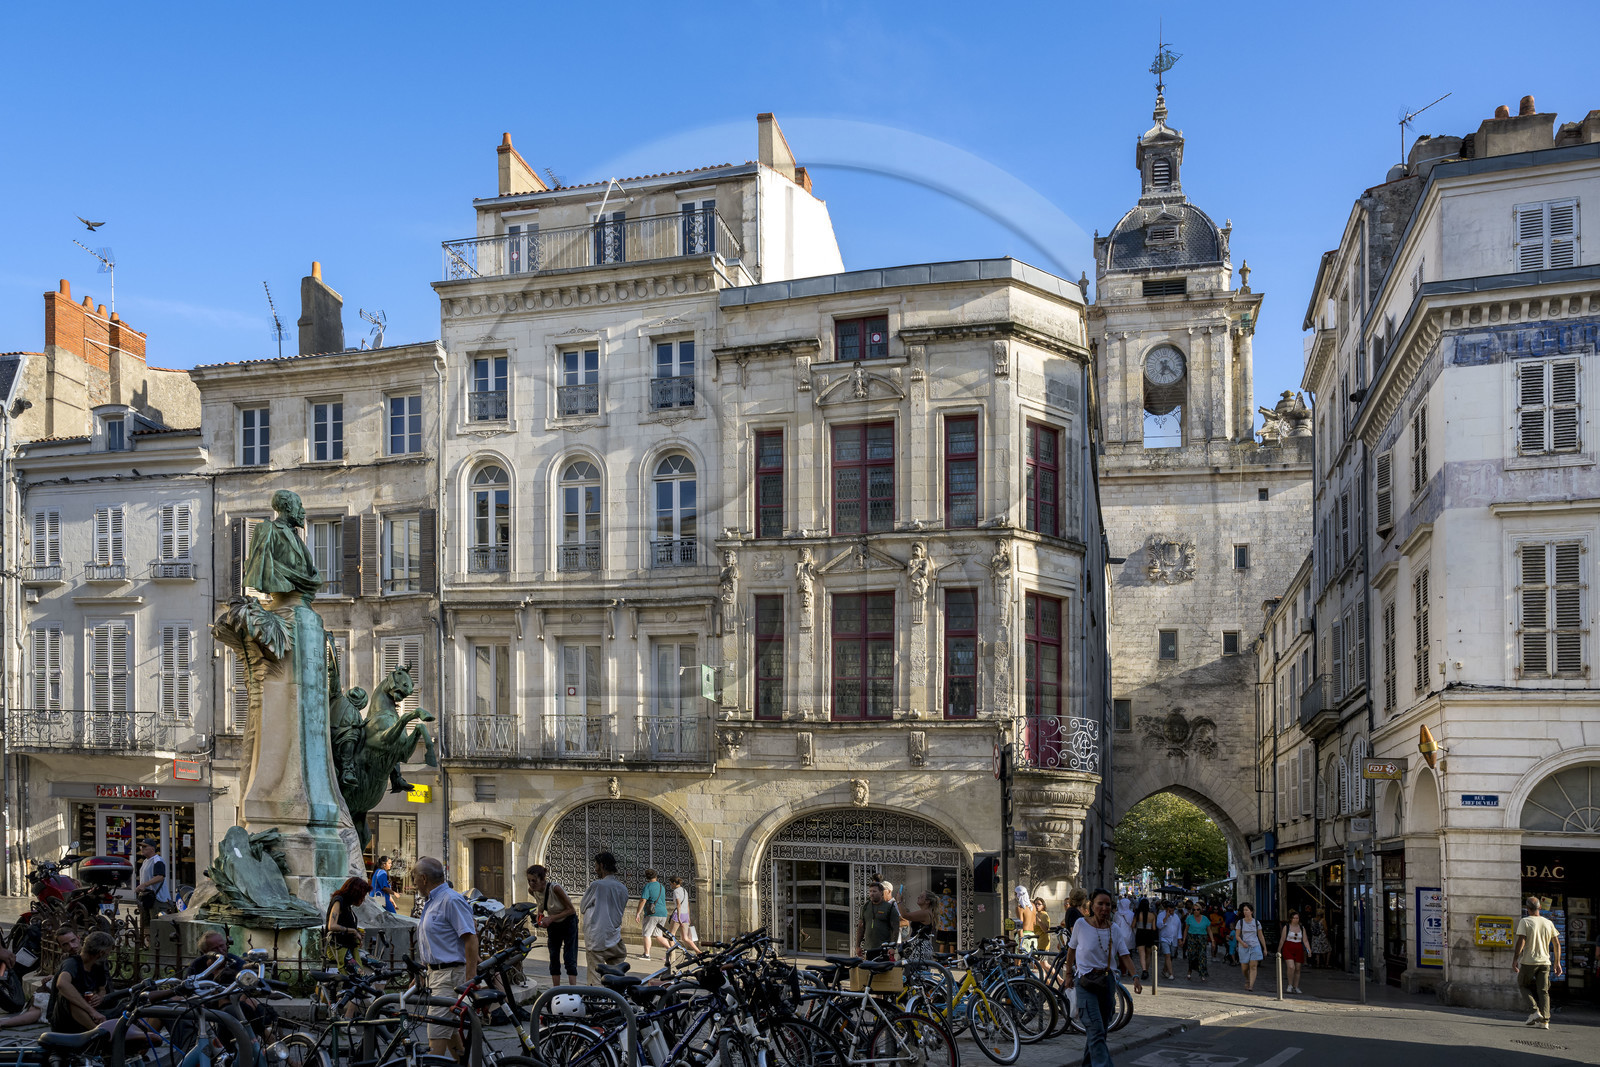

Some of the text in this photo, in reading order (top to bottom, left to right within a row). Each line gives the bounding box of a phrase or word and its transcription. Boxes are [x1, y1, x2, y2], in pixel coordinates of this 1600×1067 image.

[96, 785, 157, 798] Foot Locker
[1521, 865, 1565, 879] BAC
[1427, 918, 1442, 928] 13
